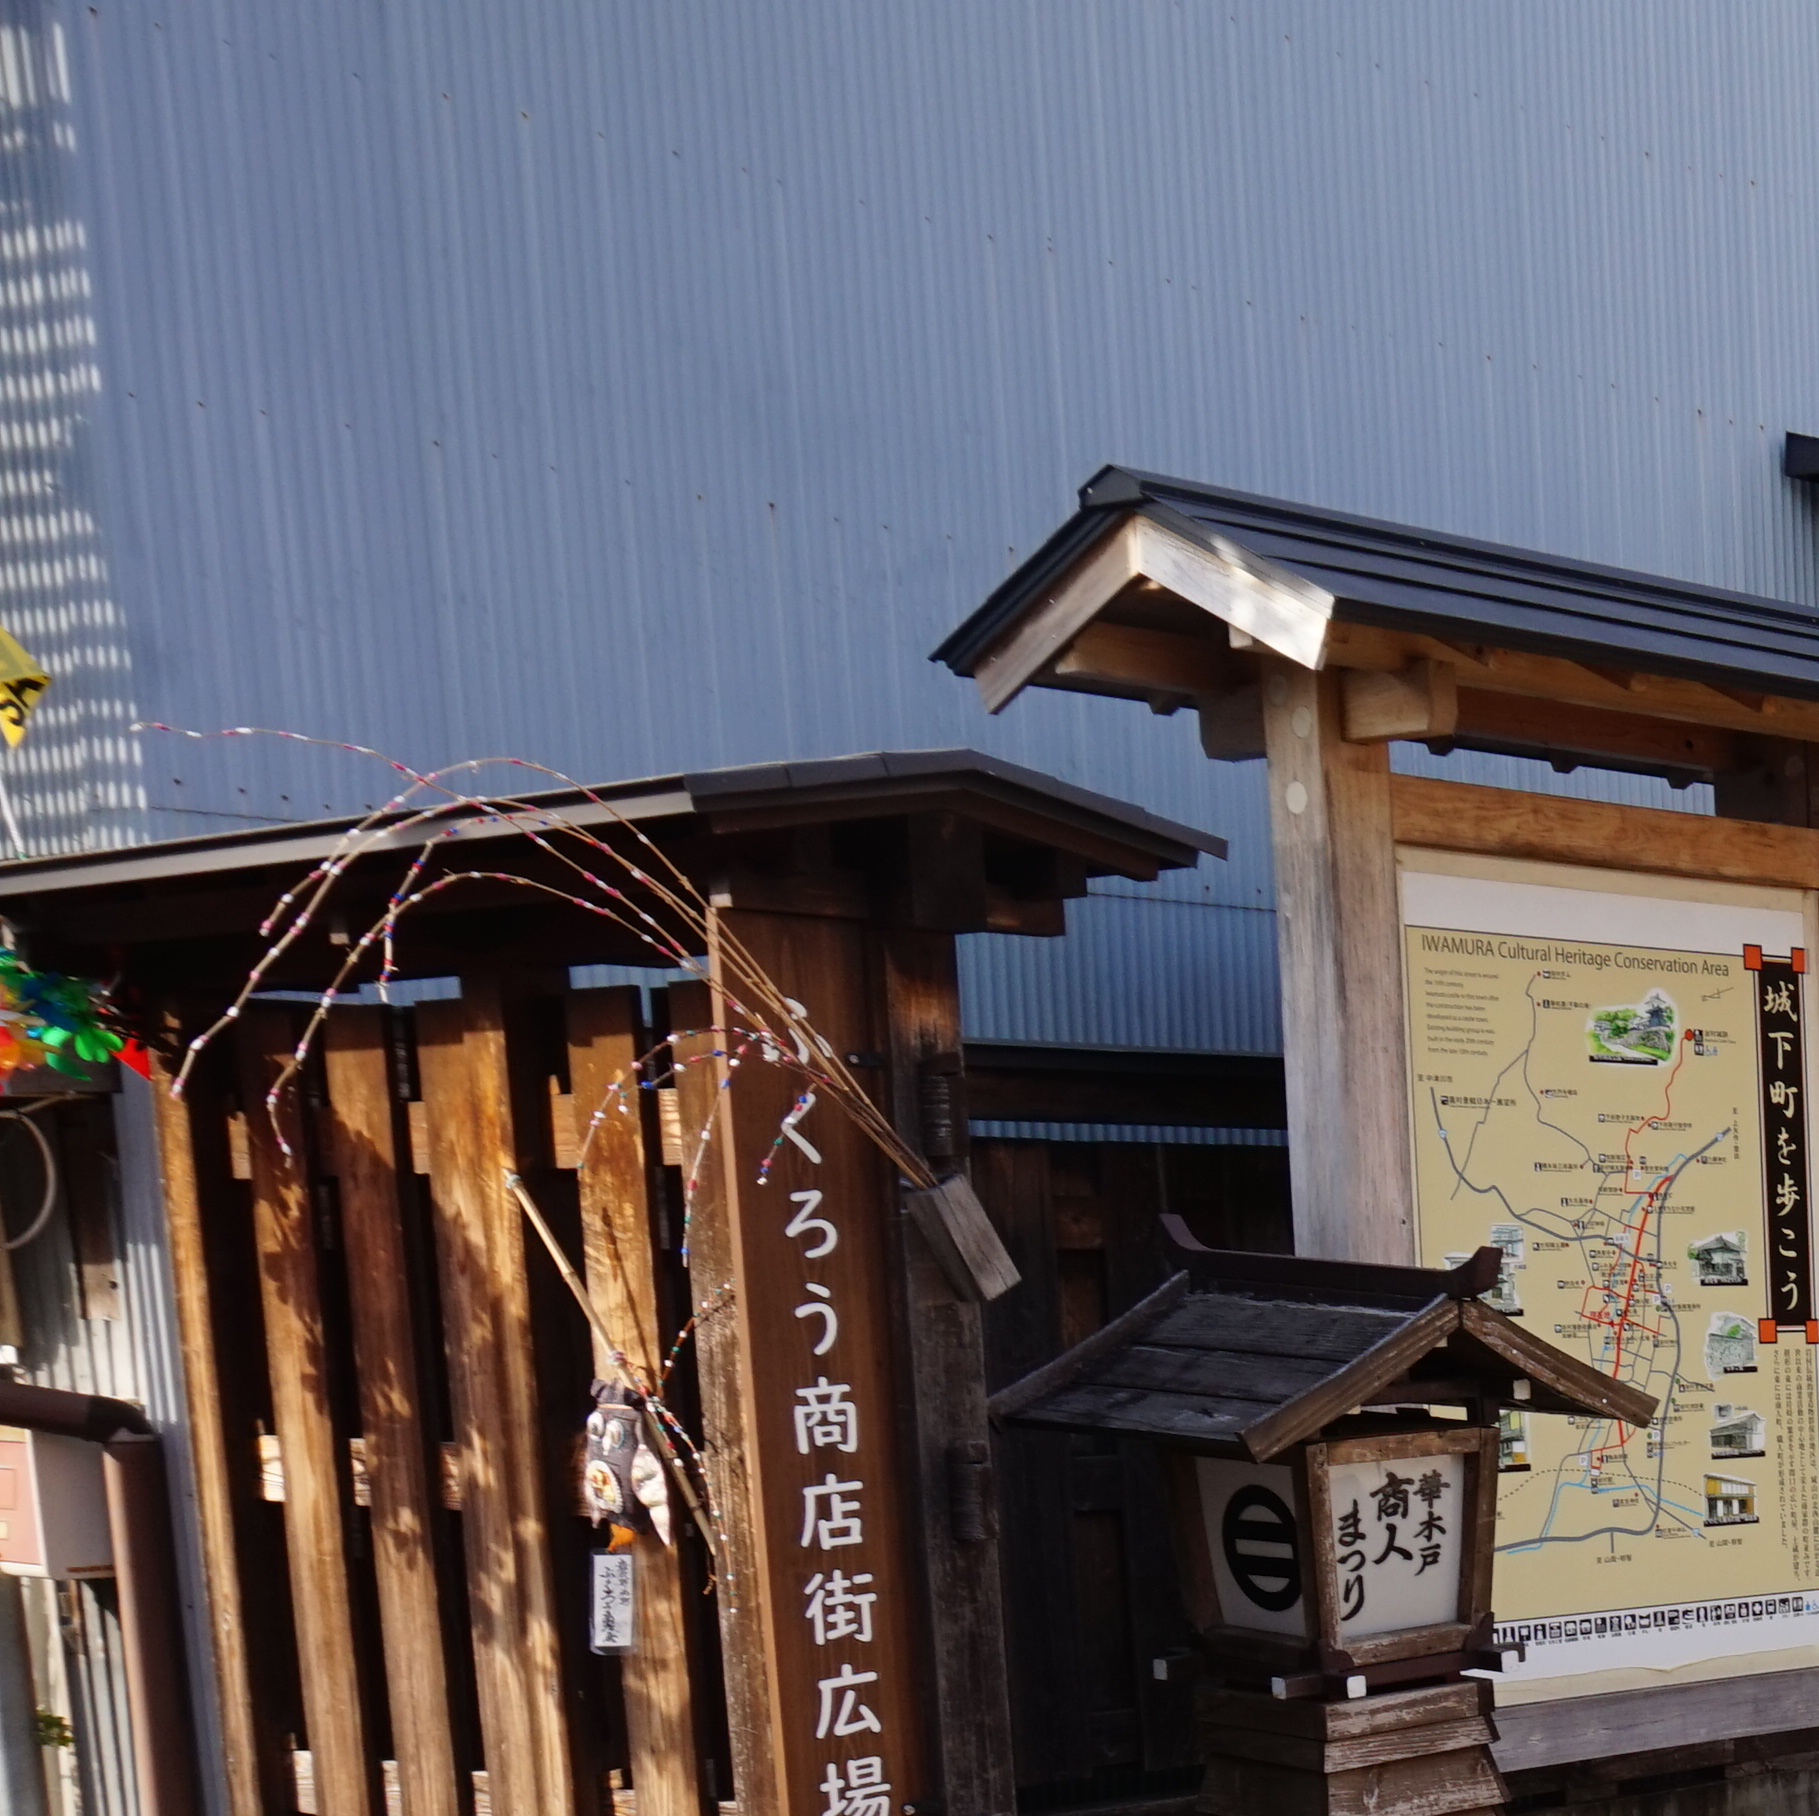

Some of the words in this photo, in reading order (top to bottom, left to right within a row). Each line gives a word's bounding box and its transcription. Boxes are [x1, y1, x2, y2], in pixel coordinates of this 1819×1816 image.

[1421, 933, 1495, 957] IWAMURA
[1498, 940, 1551, 963] Cultural
[1555, 946, 1611, 971] Heritage
[1614, 951, 1698, 975] Conservation
[1701, 959, 1730, 977] Area
[1762, 981, 1801, 1311] 城下町を歩こう
[1337, 1498, 1367, 1622] まつり
[1370, 1472, 1415, 1565] 商人
[1412, 1468, 1451, 1577] 華木戸
